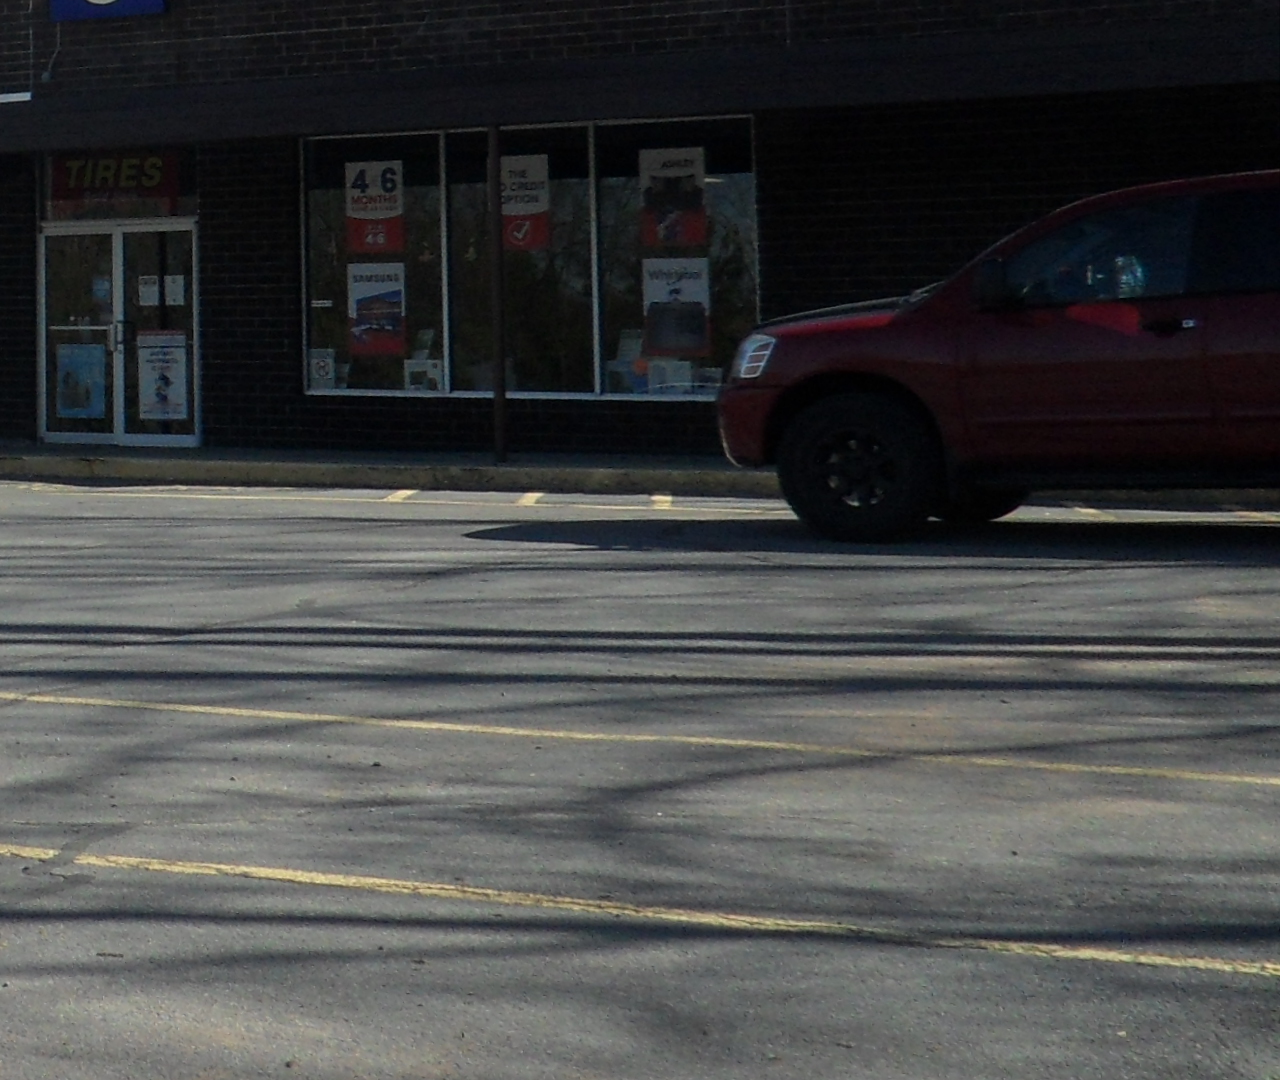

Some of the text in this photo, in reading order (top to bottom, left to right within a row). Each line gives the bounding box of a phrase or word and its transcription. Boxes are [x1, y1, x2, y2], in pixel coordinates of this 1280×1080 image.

[66, 156, 163, 189] TIRES
[351, 195, 398, 205] MONTHS
[352, 274, 400, 283] SAMSUNG
